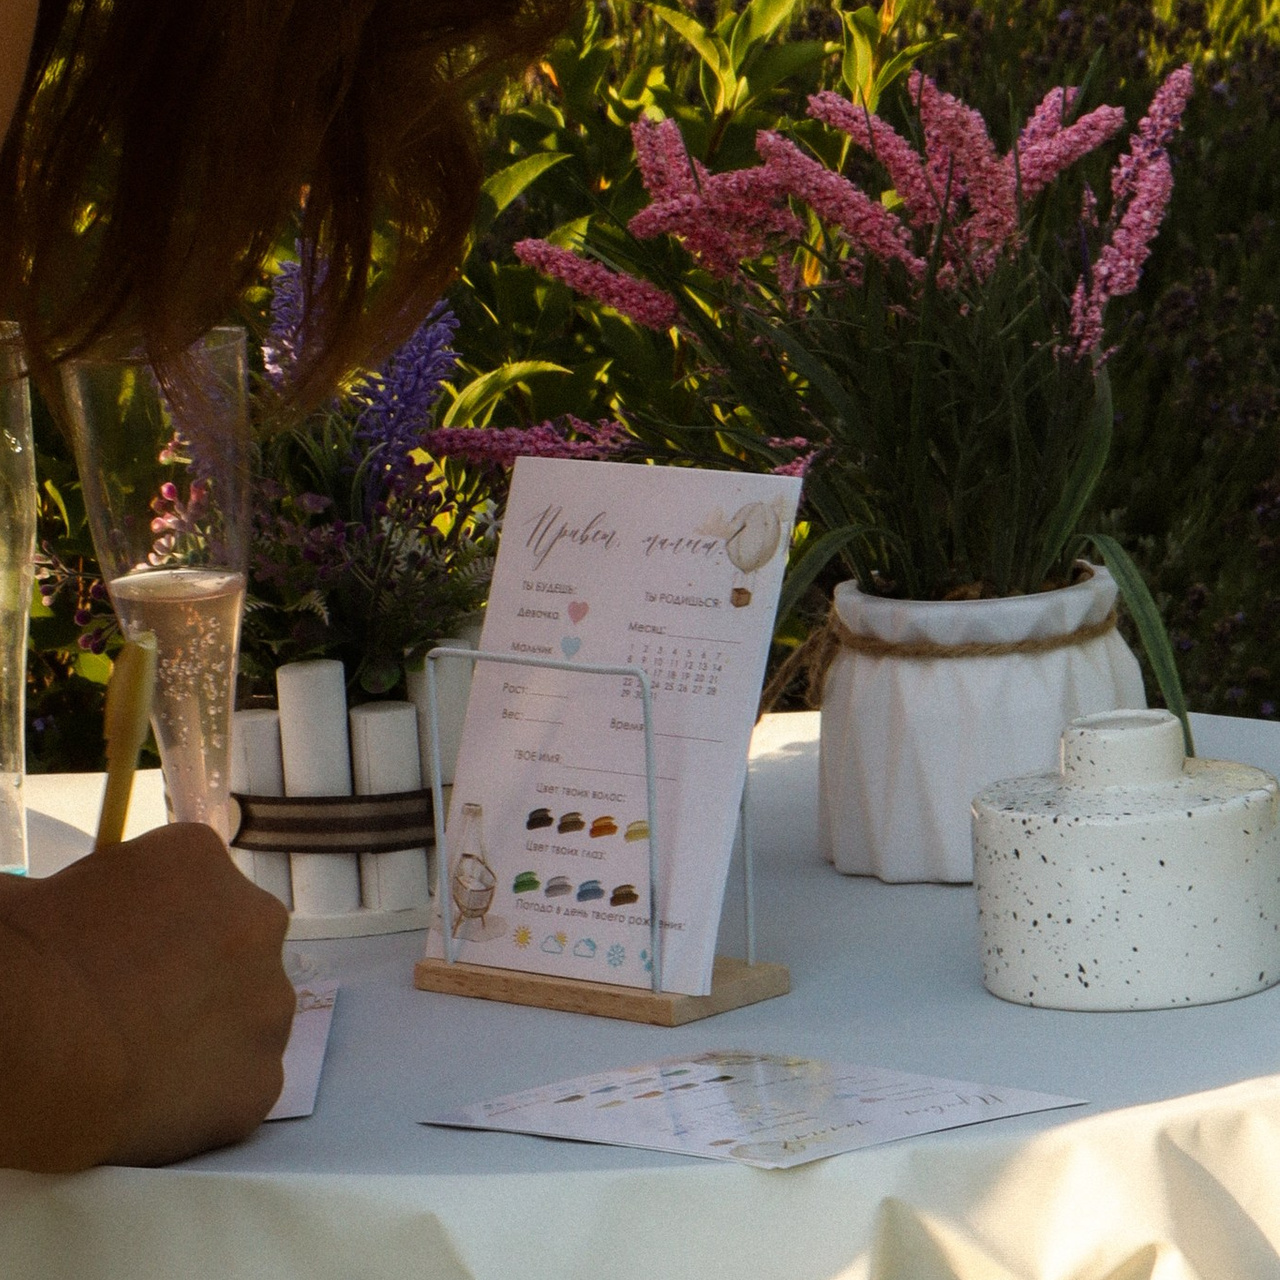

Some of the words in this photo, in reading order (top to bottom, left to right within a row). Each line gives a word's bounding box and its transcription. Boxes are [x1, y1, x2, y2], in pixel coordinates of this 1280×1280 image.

[513, 748, 537, 761] ТВОЕ
[535, 782, 558, 794] Цвет
[562, 786, 590, 798] твоих
[525, 839, 548, 852] Цвет
[551, 845, 578, 857] твоих
[515, 898, 552, 914] Погода
[563, 908, 589, 919] день
[591, 909, 625, 924] твоего
[627, 914, 686, 931] рожения:
